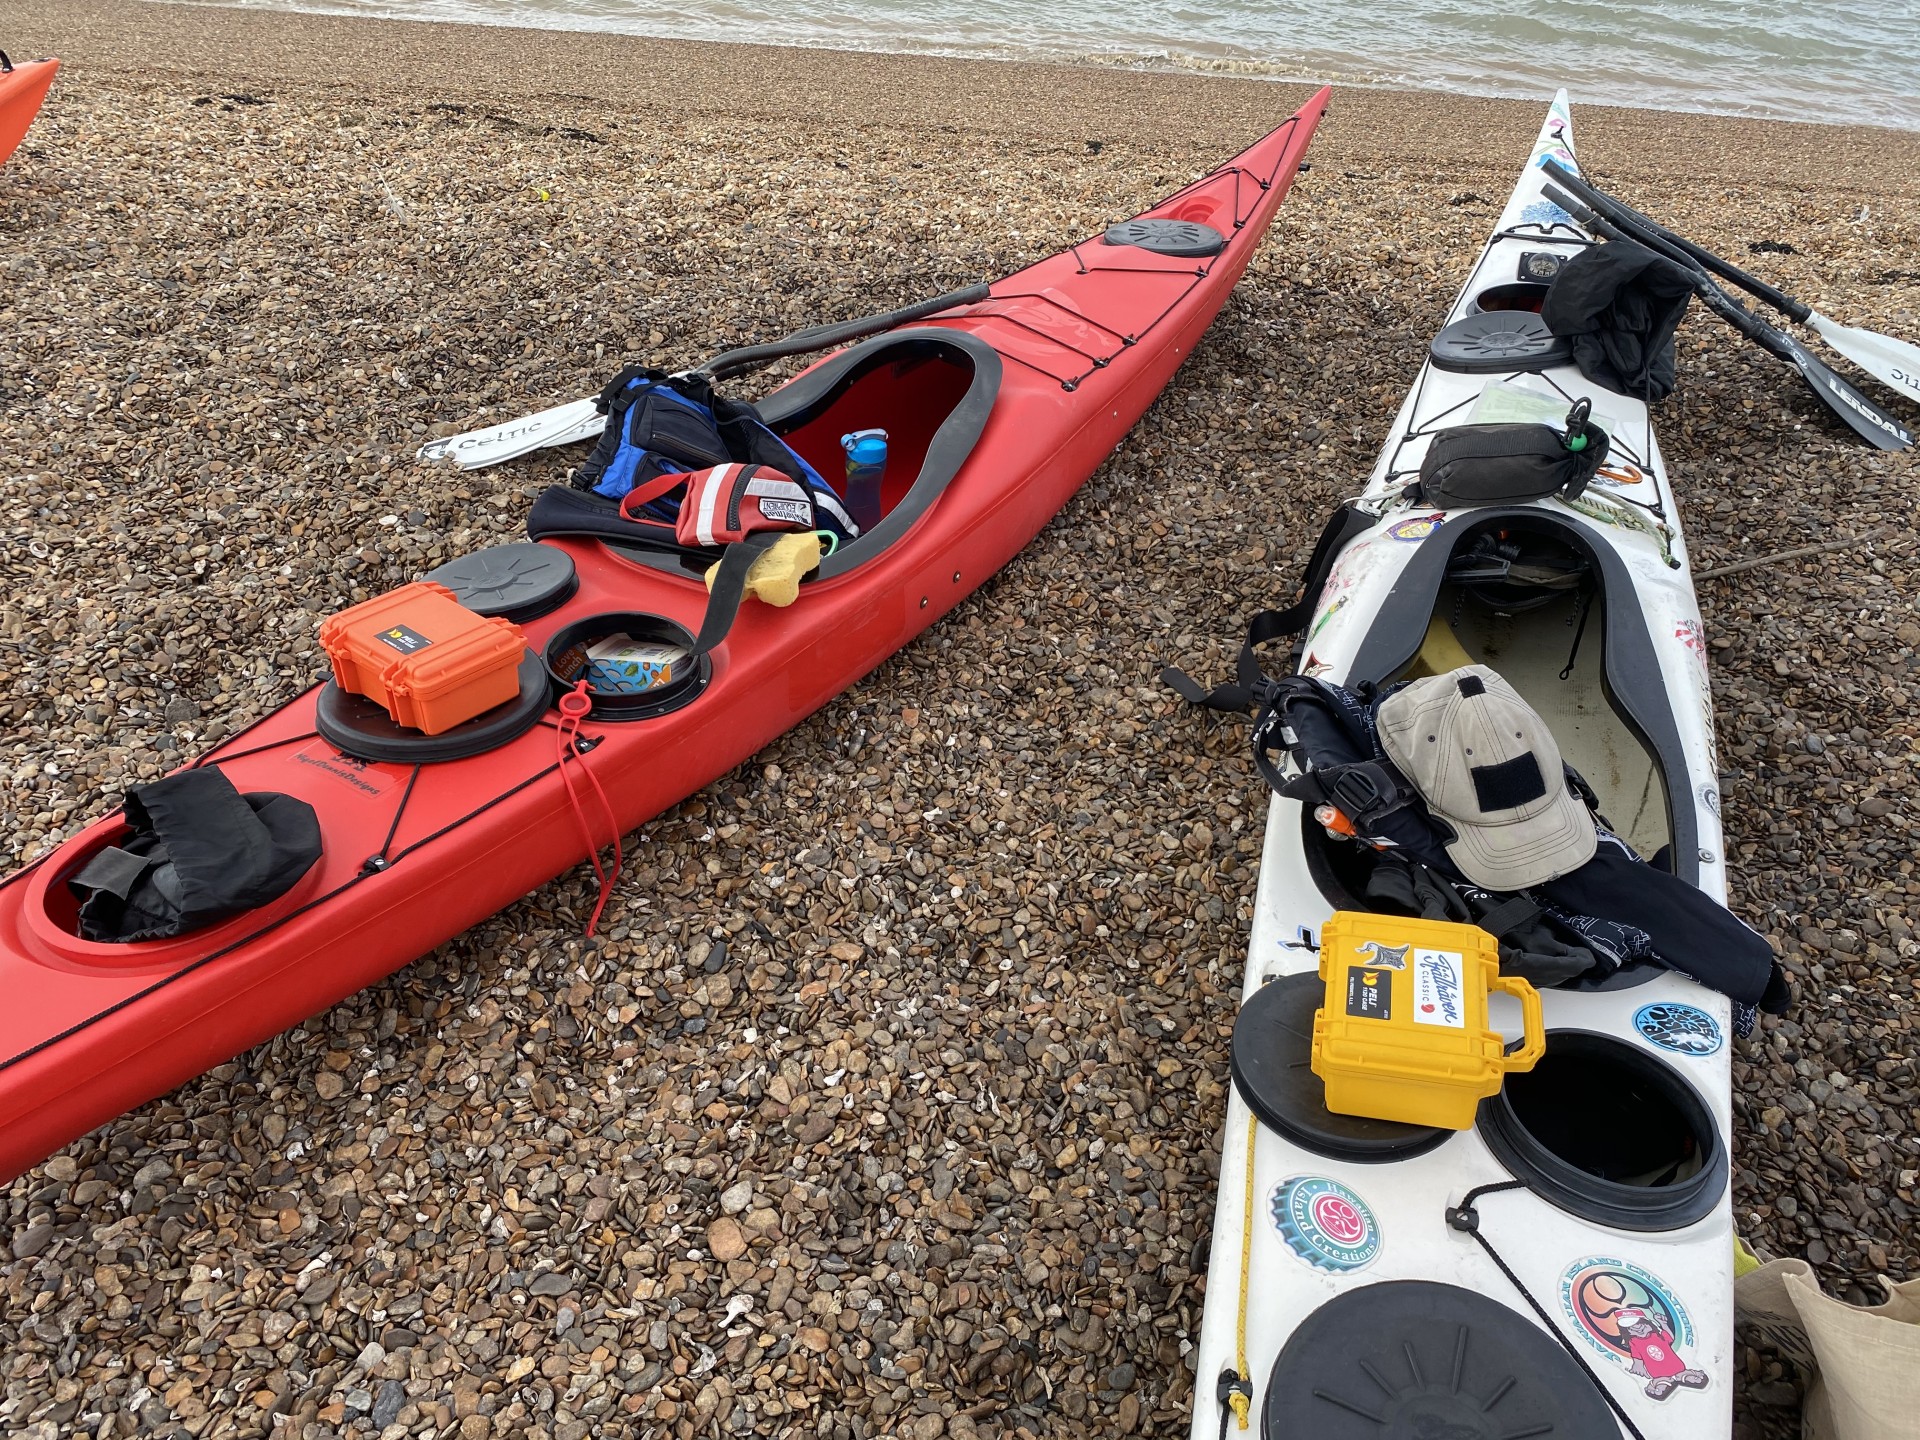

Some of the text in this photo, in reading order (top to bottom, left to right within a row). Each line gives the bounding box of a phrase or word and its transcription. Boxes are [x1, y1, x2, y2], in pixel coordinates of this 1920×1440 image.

[555, 649, 575, 670] Love
[560, 655, 583, 680] Lunch
[1368, 987, 1378, 1008] PELI
[1422, 970, 1430, 1002] CLASSIC
[1326, 1182, 1374, 1232] Hawaiian
[1294, 1186, 1375, 1261] Island Creations
[1566, 1257, 1622, 1280] ISLAND
[1626, 1263, 1694, 1348] CREATIONS
